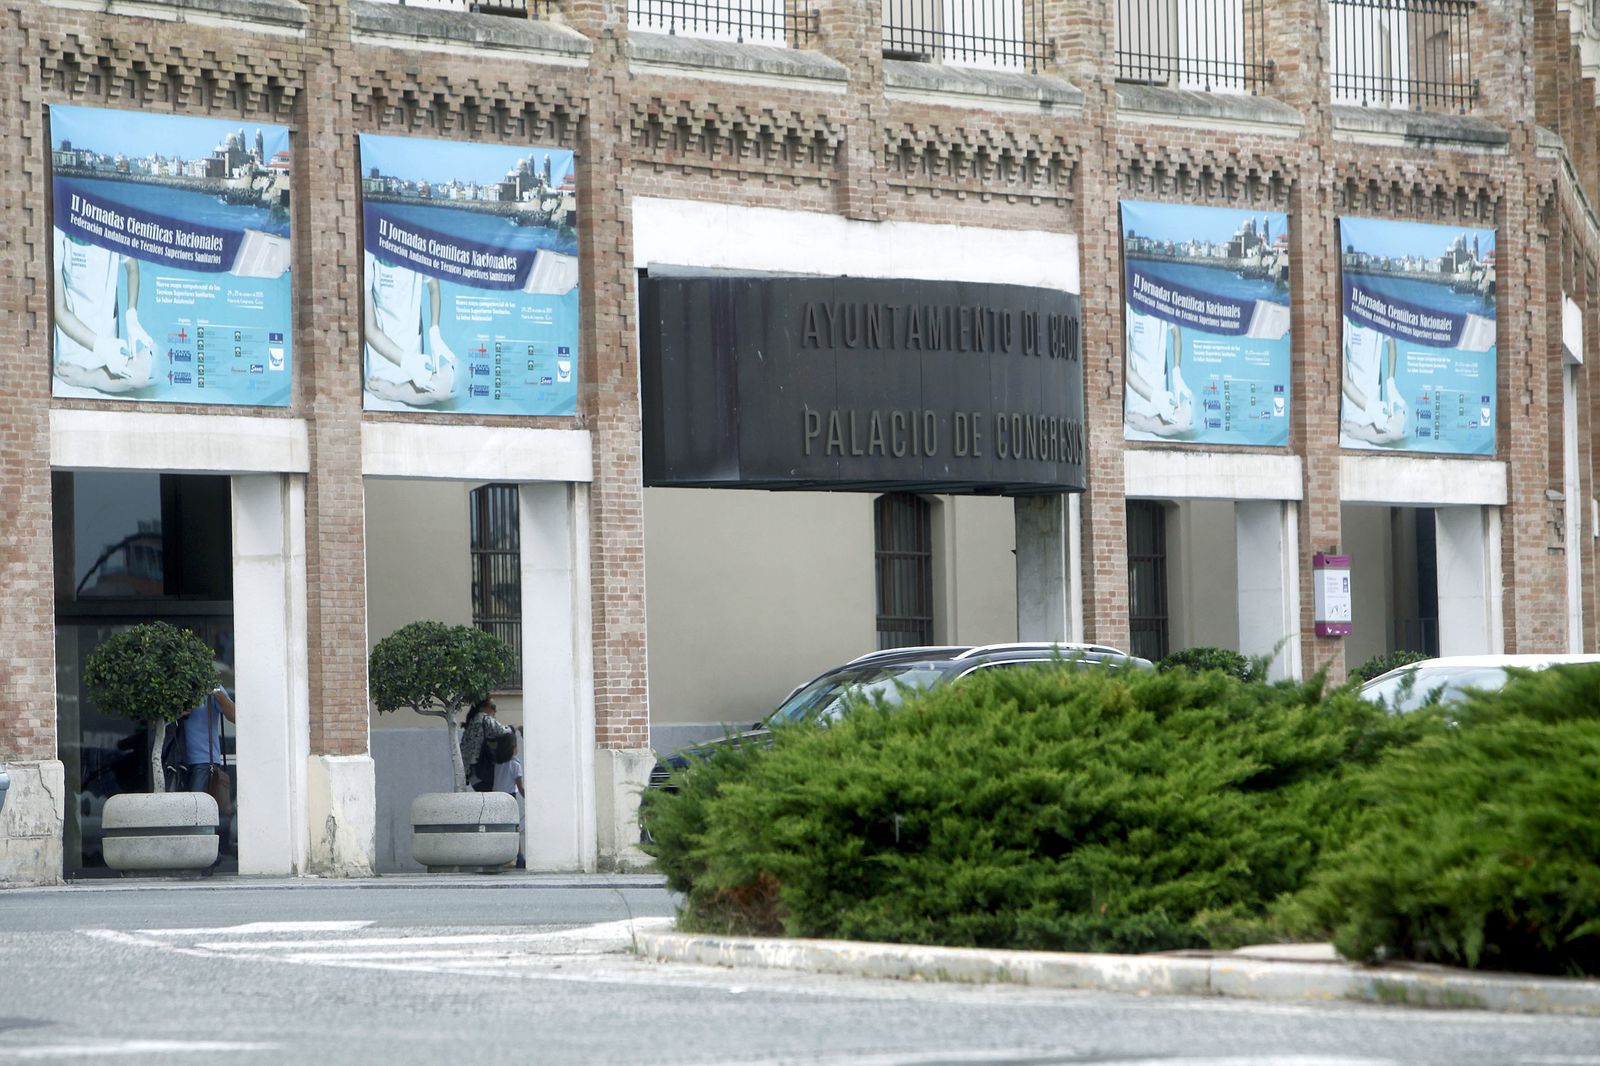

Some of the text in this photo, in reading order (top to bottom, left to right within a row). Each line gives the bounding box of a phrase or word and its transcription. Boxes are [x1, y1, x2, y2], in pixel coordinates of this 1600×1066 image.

[70, 213, 103, 236] Federación
[103, 227, 130, 245] Andaluza
[131, 238, 139, 248] de
[165, 246, 194, 261] Superiores
[194, 251, 221, 264] Sanitarios
[71, 194, 223, 251] II Jornadas Científicas Nacionales
[379, 218, 517, 270] II Jornadas Científicas Nacionales
[433, 259, 439, 269] de
[1140, 277, 1171, 302] Jornadas
[1206, 301, 1240, 318] Nacionales
[1358, 291, 1387, 315] Jornadas
[1420, 314, 1452, 331] Nacionales
[803, 302, 1011, 353] AYUNTAMIENTO
[1022, 310, 1042, 356] DE
[804, 408, 938, 457] PALACIO
[953, 411, 983, 457] DE
